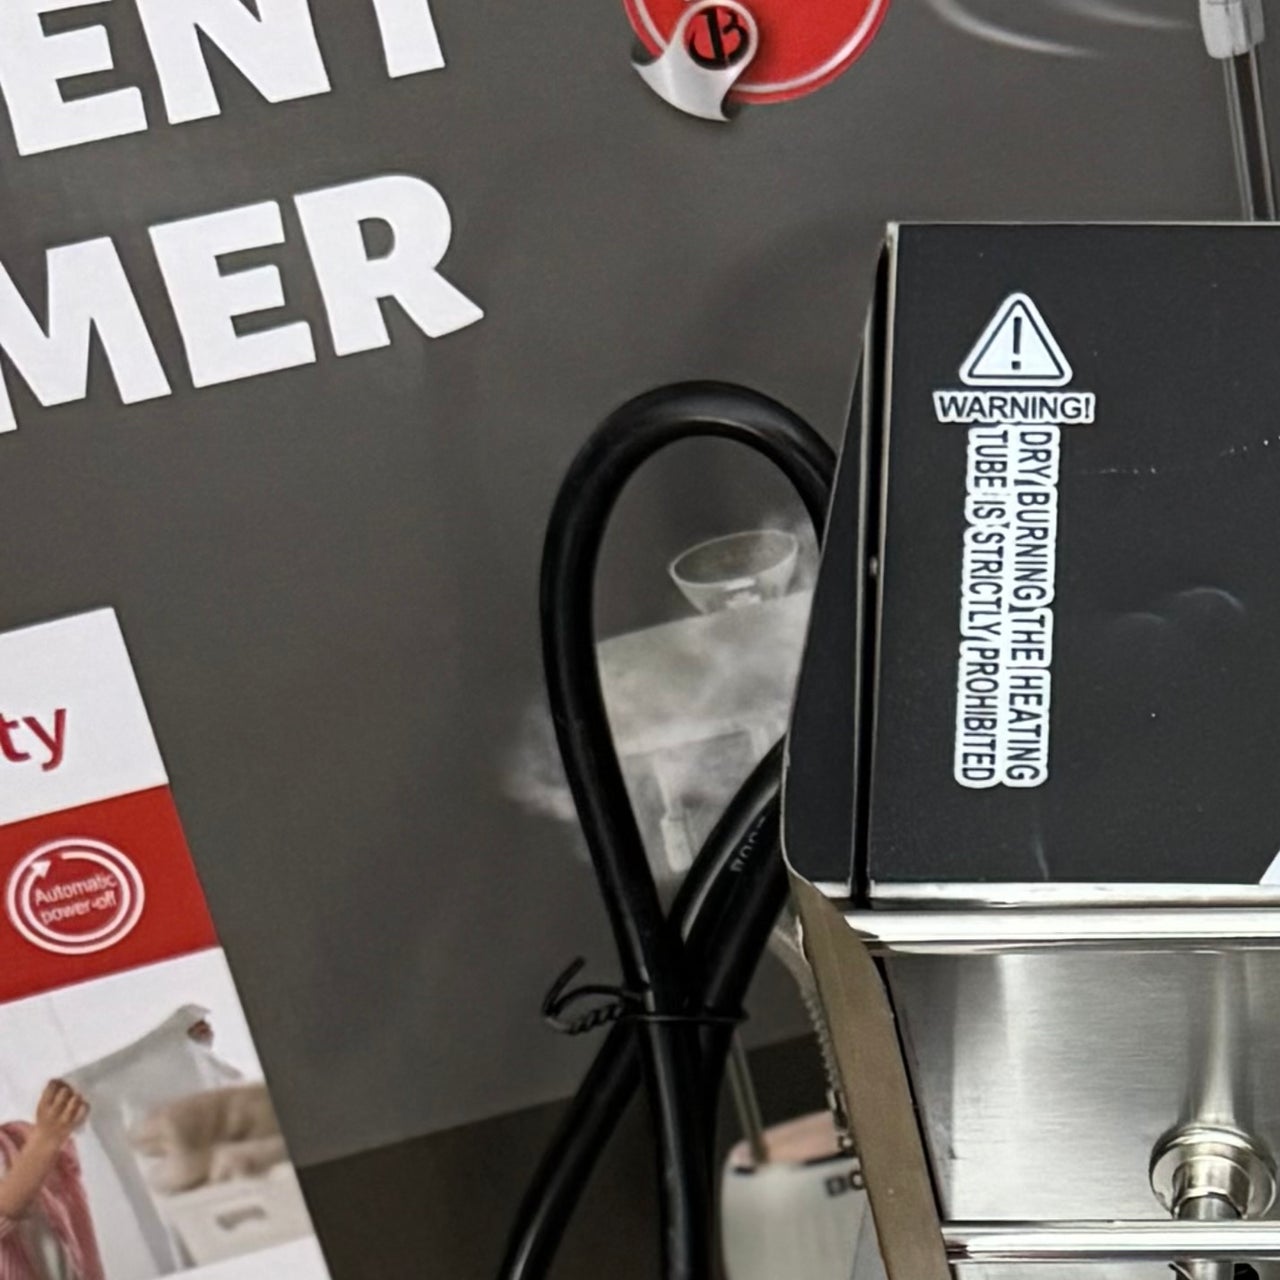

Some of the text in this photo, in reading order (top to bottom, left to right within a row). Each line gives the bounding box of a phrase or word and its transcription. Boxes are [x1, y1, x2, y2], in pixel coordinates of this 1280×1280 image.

[939, 396, 1091, 420] WARNING!
[961, 429, 1009, 782] TUBE IS STRICTLY PROHIBITED
[1005, 430, 1053, 781] DRY BURNING THE HEATING
[35, 874, 117, 907] Automatic
[41, 889, 117, 926] power-off
